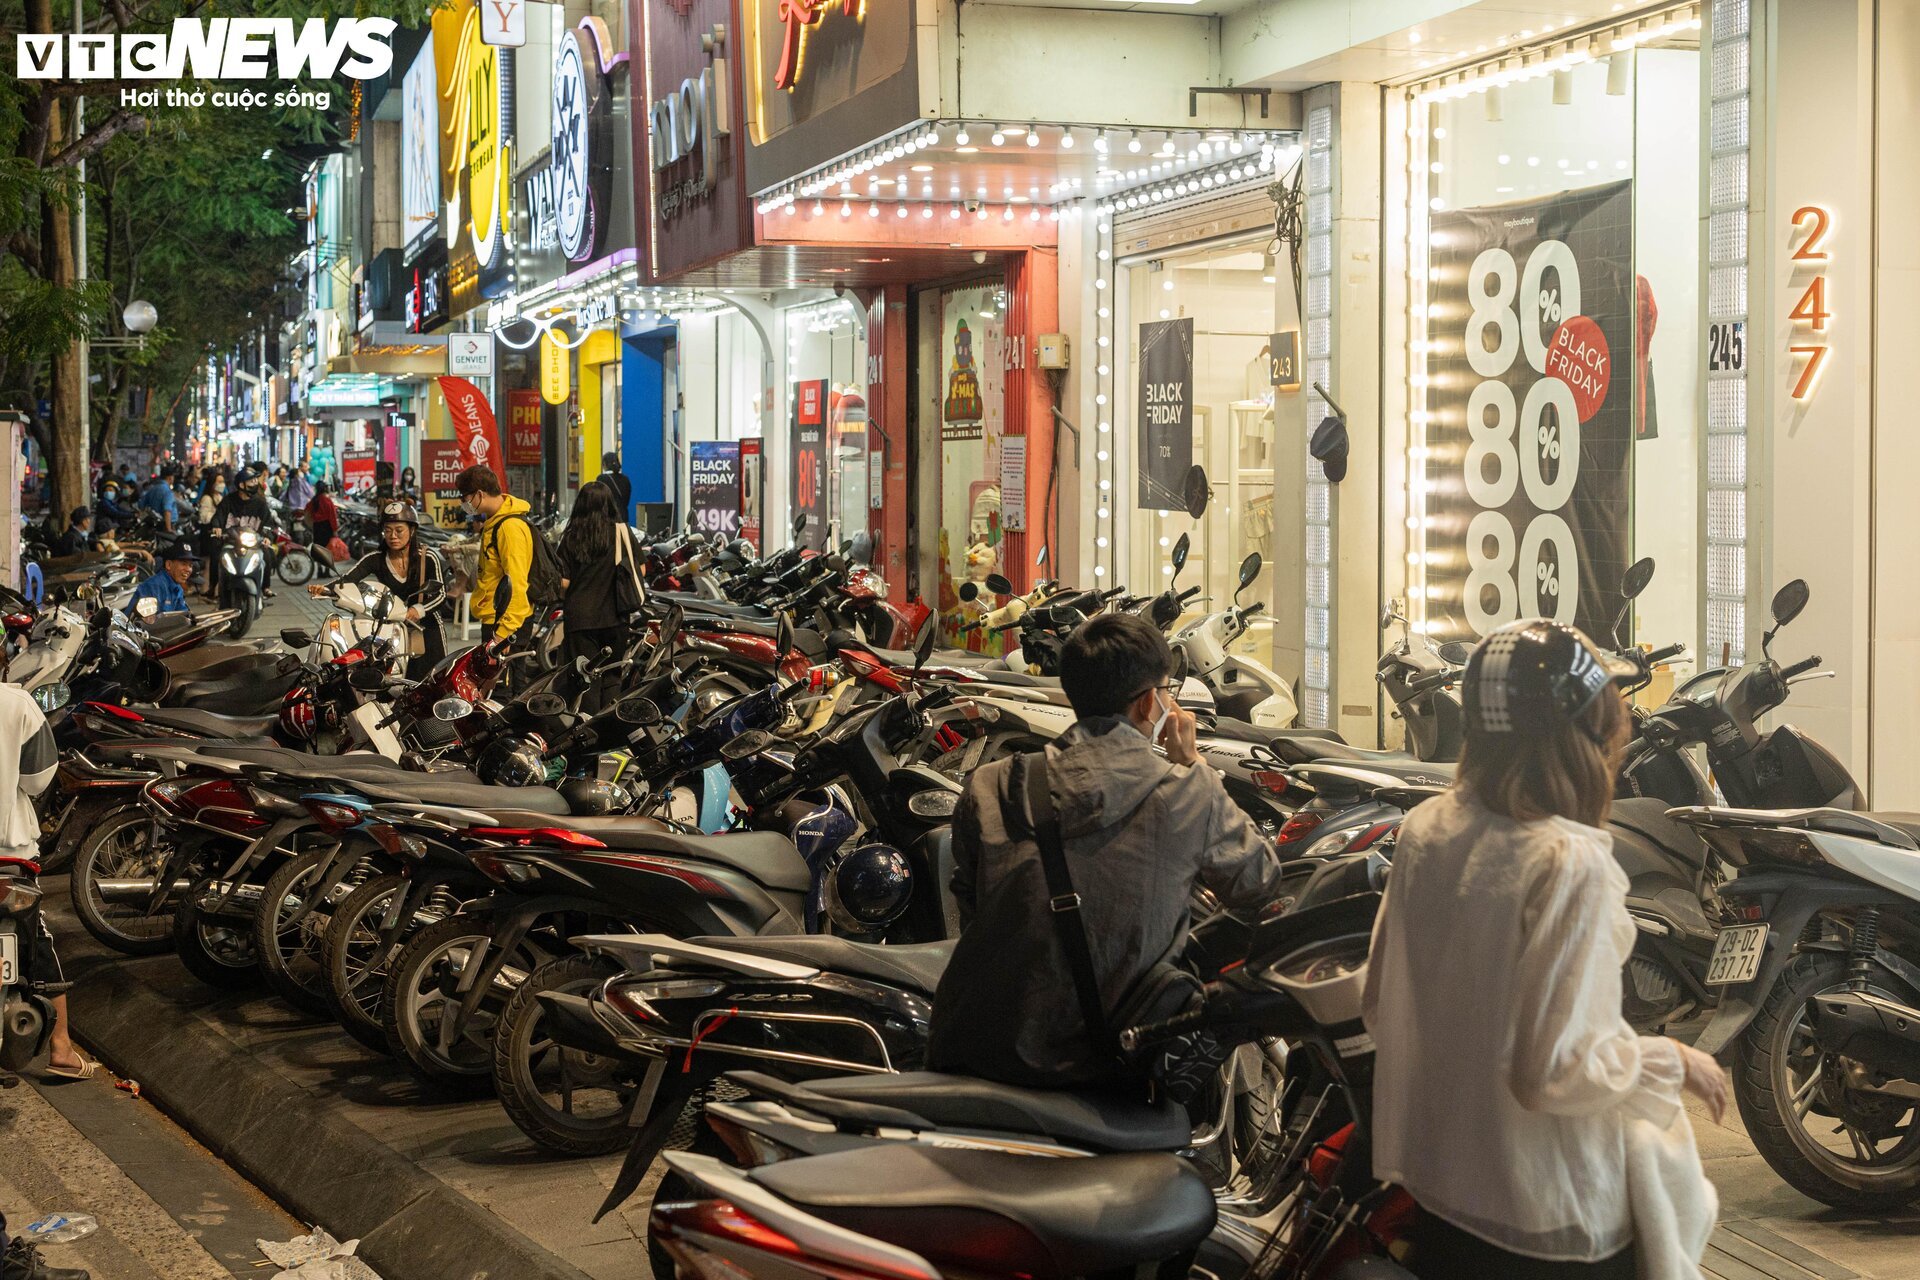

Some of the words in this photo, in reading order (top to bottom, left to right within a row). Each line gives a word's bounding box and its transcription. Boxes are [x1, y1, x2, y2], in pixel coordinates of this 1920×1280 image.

[469, 48, 493, 150] LILY
[1788, 206, 1830, 399] 247
[455, 356, 487, 364] GENVIET
[1005, 335, 1025, 371] 241
[1558, 327, 1607, 375] BLACK
[1709, 323, 1743, 371] 245
[868, 354, 883, 385] 241
[1272, 357, 1291, 379] 243
[1549, 348, 1603, 399] FRIDAY
[1146, 382, 1183, 403] BLACK
[461, 393, 484, 436] JEANS
[1146, 405, 1183, 424] FRIDAY
[1159, 445, 1171, 458] 70%
[692, 460, 732, 471] BLACK
[692, 473, 735, 484] FRIDAY
[798, 449, 815, 508] 80
[1211, 750, 1245, 759] mode
[1720, 928, 1760, 954] 29-D2
[1709, 954, 1755, 980] 237.74
[726, 993, 813, 1002] LEAD
